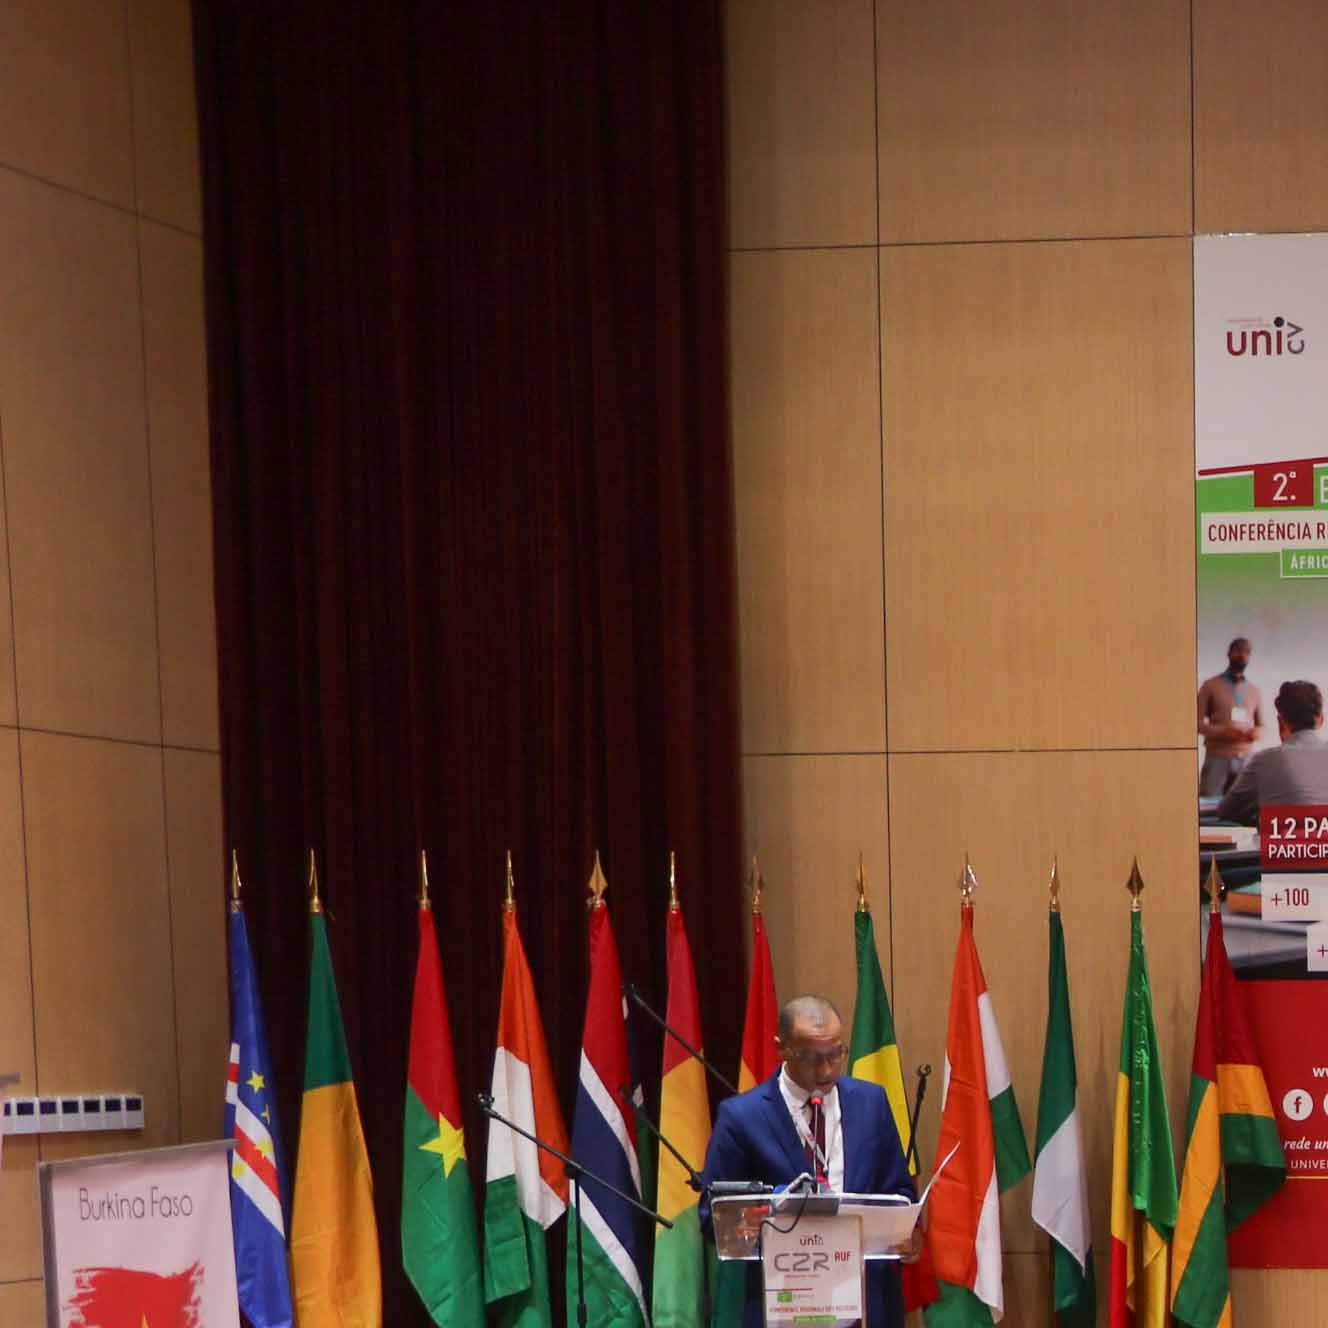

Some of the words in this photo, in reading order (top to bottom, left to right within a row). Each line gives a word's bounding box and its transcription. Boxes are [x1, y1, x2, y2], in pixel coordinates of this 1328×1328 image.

[1208, 519, 1313, 543] CONFERÊNCIA
[1269, 817, 1297, 840] 12
[1271, 888, 1310, 908] +100
[1284, 1136, 1311, 1151] rede
[79, 1187, 145, 1221] Burkina
[151, 1187, 193, 1218] Faso
